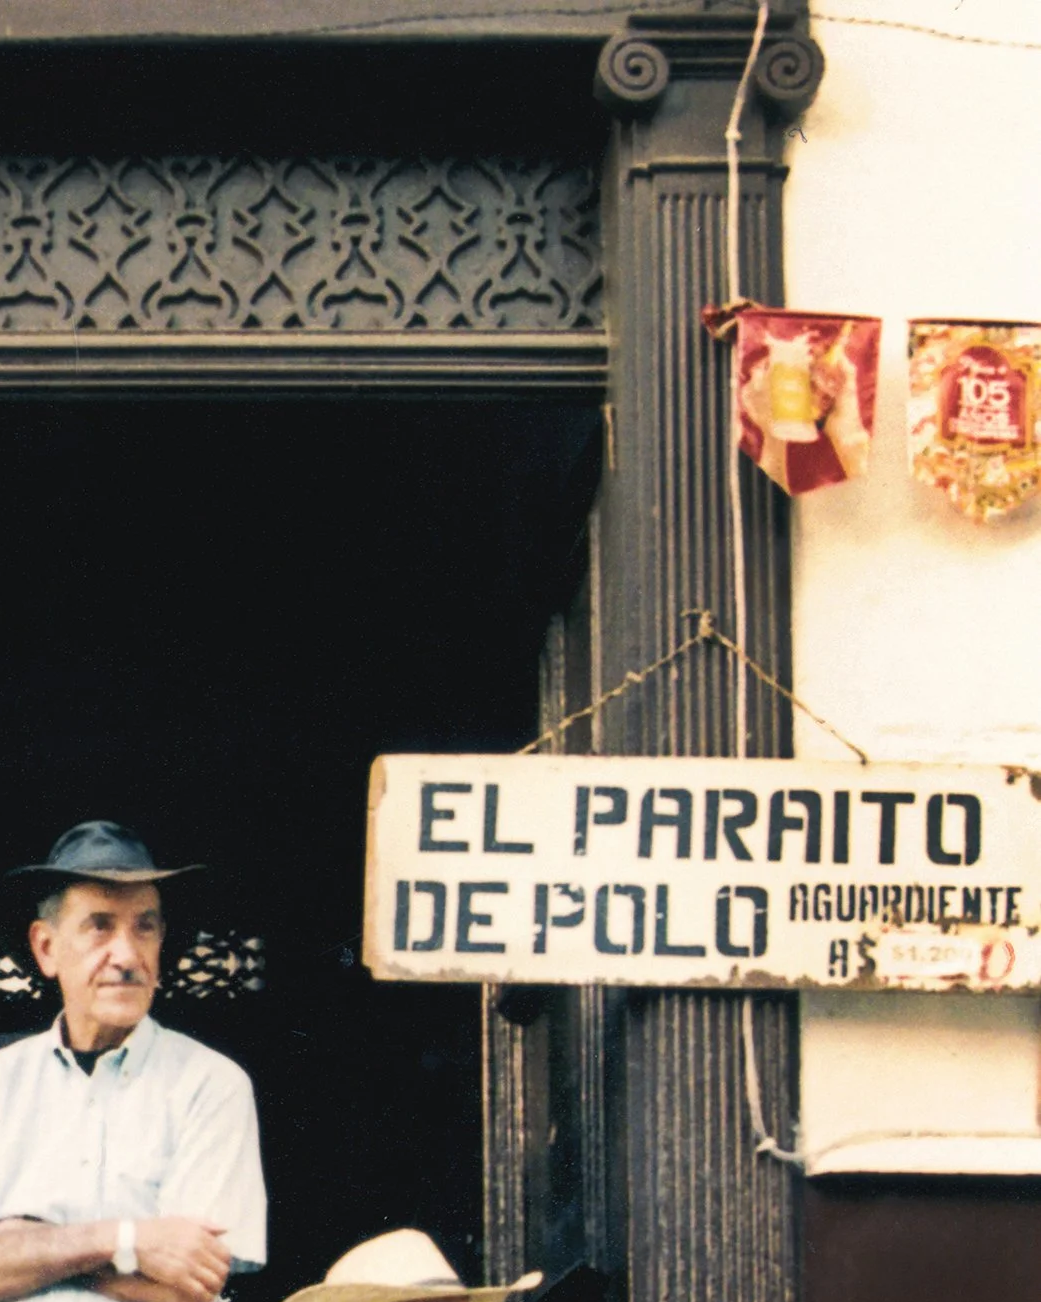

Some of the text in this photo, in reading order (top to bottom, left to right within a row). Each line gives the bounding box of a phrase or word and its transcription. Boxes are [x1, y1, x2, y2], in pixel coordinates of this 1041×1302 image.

[958, 375, 1010, 407] 105
[418, 782, 982, 866] EL PARAITO
[394, 880, 769, 958] DE POLO
[789, 883, 1023, 926] AGUARDIENTE
